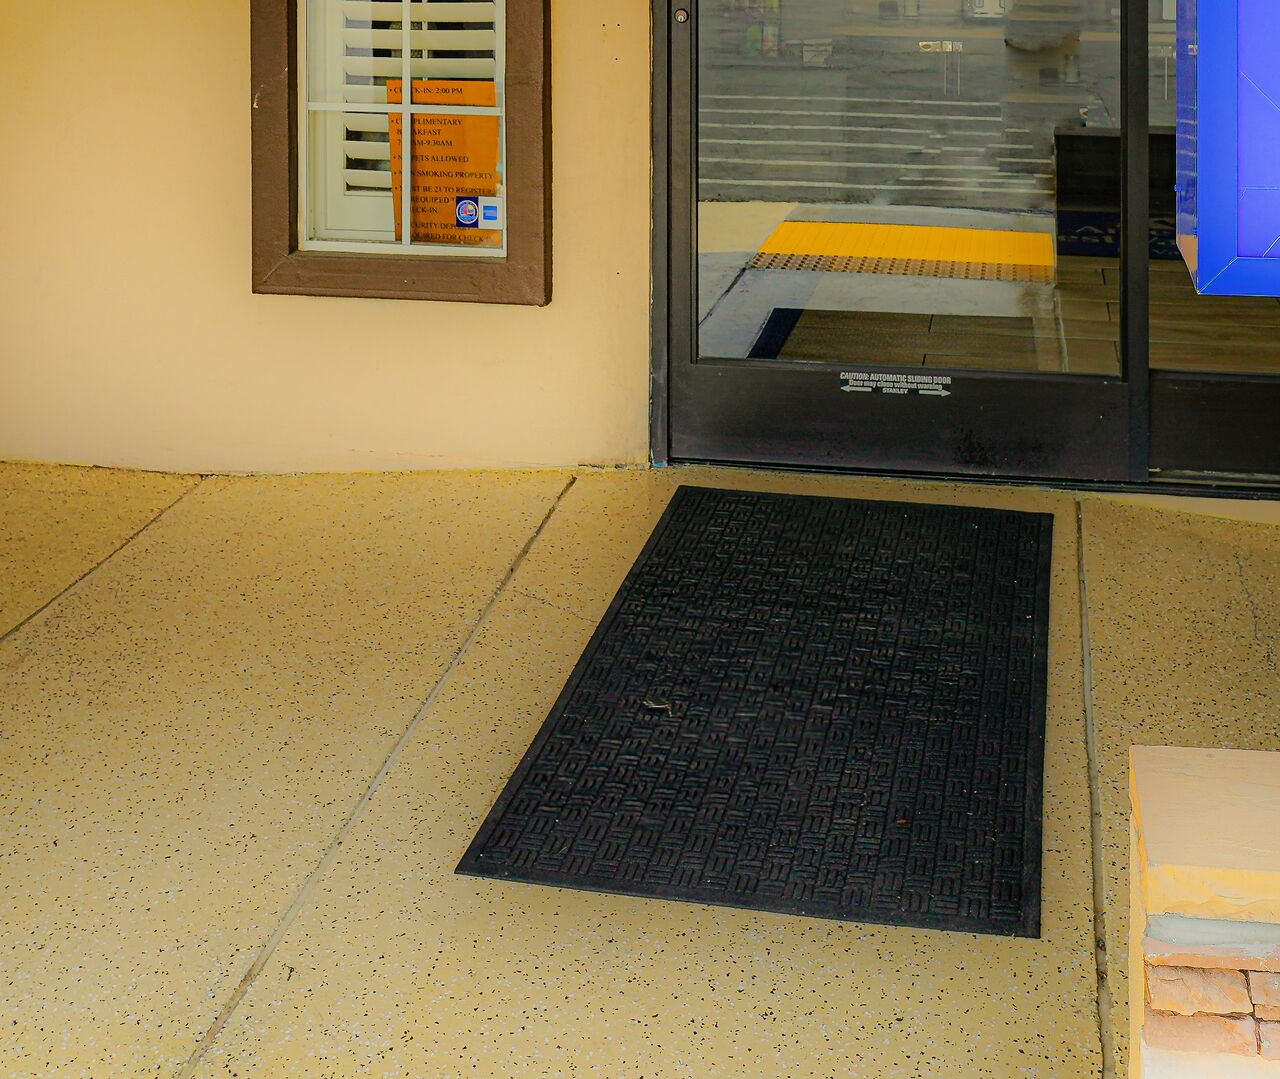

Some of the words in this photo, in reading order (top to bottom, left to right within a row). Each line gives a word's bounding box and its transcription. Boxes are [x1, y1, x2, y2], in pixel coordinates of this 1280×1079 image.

[417, 170, 453, 178] SMOKING
[455, 172, 493, 180] PROPERTY
[444, 186, 454, 194] TO
[840, 372, 869, 380] CAUTION:
[870, 373, 907, 382] AUTOMATIC
[907, 375, 933, 383] SLIDING
[933, 376, 951, 384] DOOR
[894, 381, 917, 389] without
